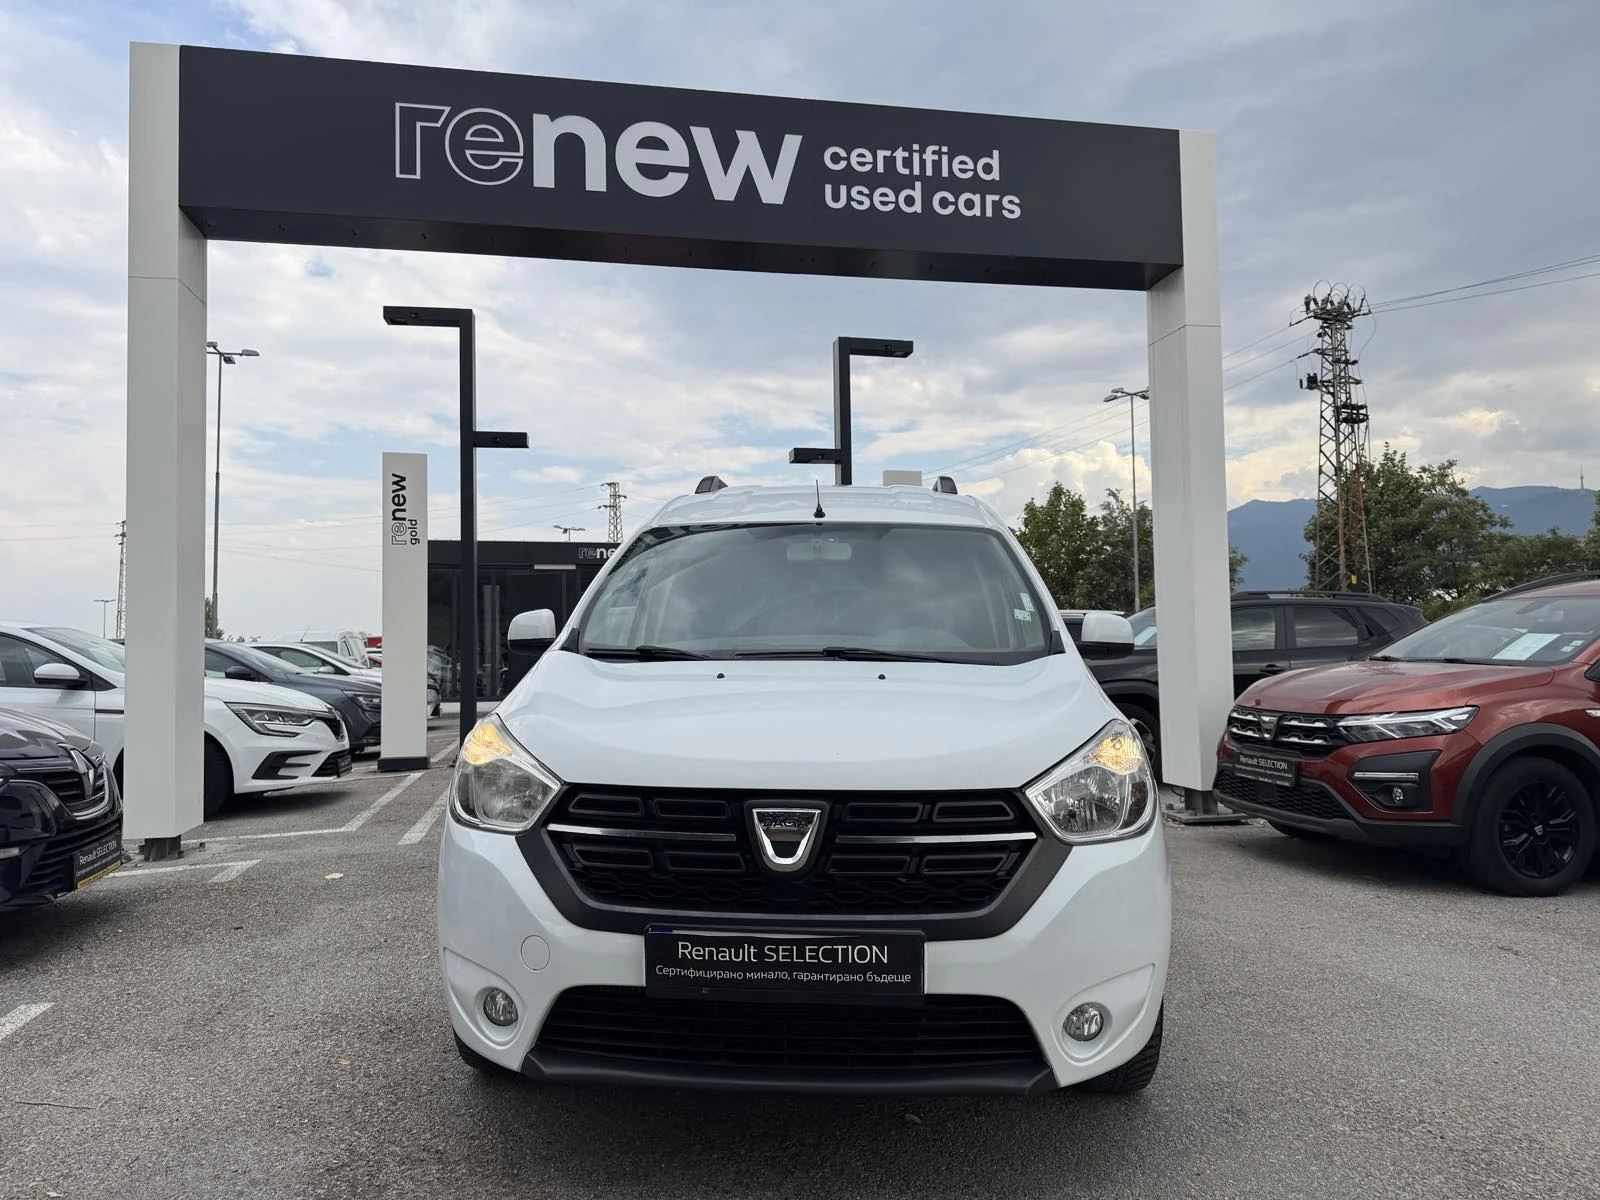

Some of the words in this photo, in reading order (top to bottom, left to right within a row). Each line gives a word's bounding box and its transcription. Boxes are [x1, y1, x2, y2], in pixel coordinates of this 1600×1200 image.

[395, 102, 803, 205] renew
[824, 144, 1000, 181] certified
[824, 182, 922, 214] used
[932, 188, 1021, 219] cars
[392, 473, 407, 545] renew
[408, 519, 420, 545] gold
[579, 547, 617, 559] rene
[1258, 758, 1288, 770] SELECTION
[678, 941, 758, 963] Renault
[764, 944, 888, 964] SELECTION
[655, 965, 744, 980] Сертифицирано
[746, 970, 791, 981] минало,
[793, 971, 864, 984] гарантирано
[866, 971, 911, 984] бъдеще
